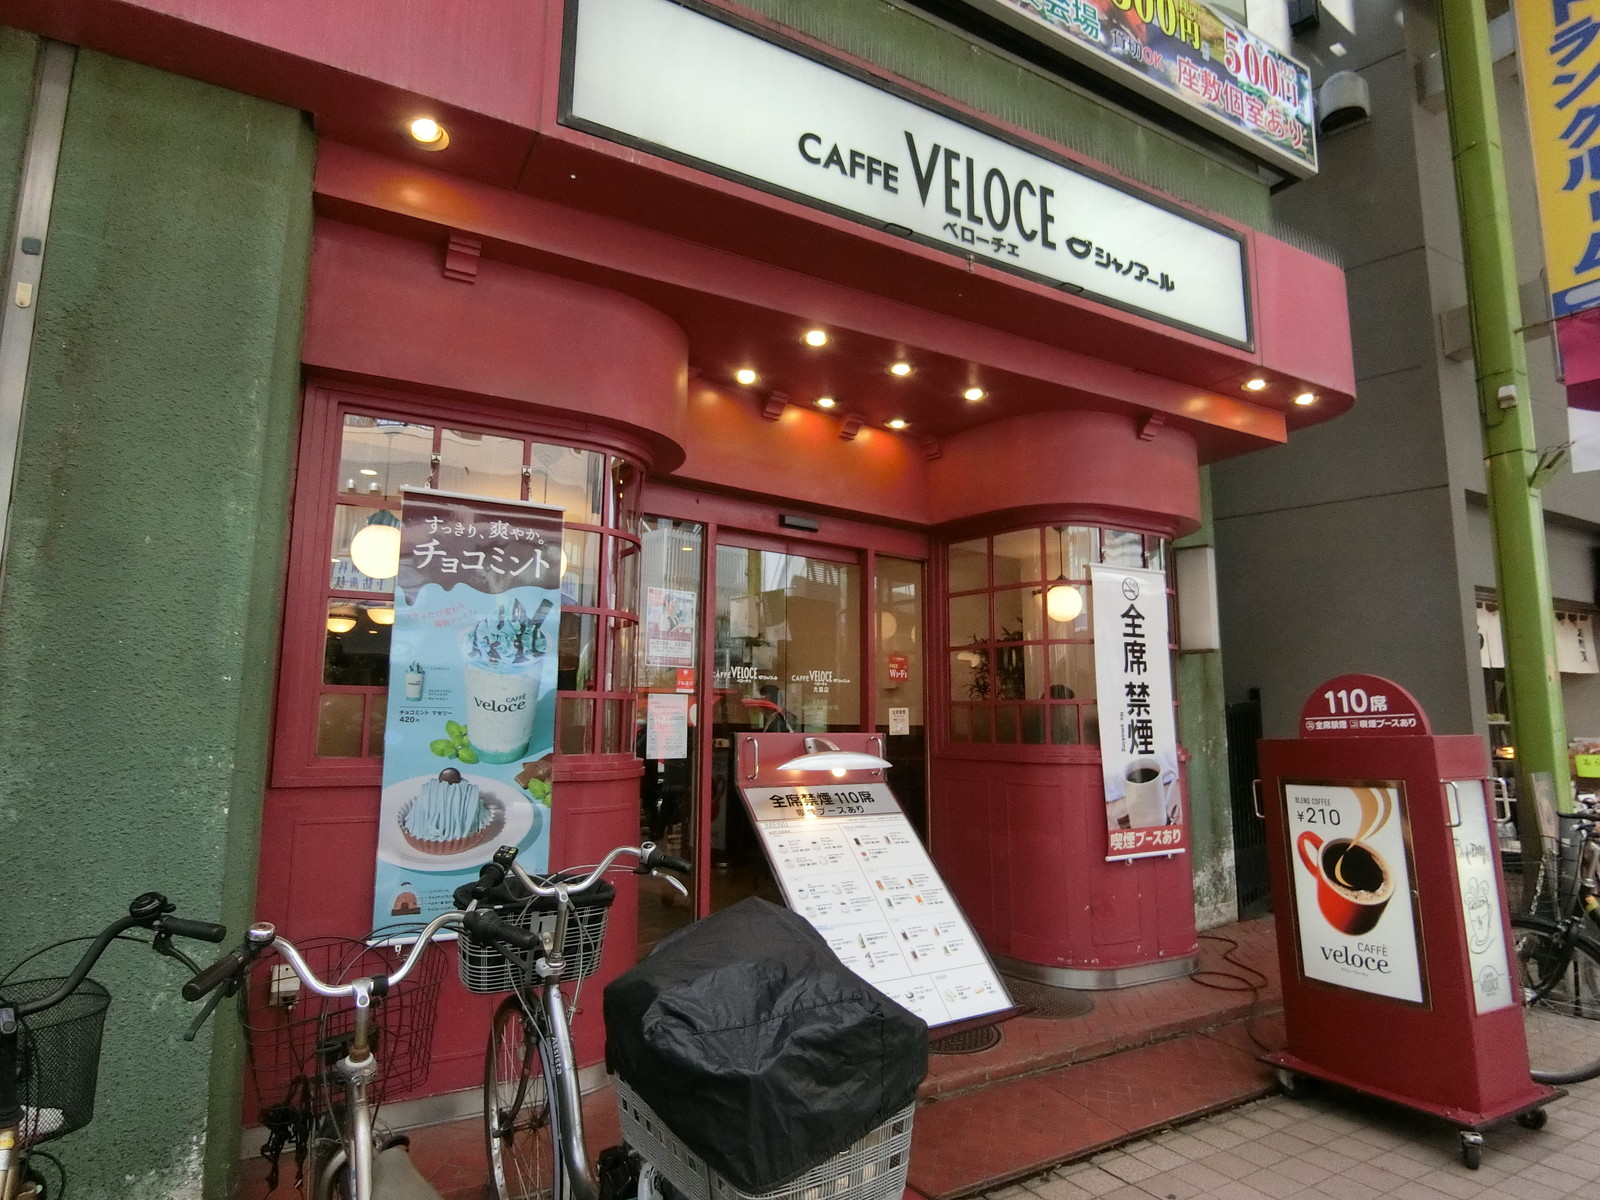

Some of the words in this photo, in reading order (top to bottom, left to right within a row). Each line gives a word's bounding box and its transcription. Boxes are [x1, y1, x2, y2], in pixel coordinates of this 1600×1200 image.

[1225, 31, 1298, 108] 500円
[1177, 57, 1303, 147] 座敷個室あり
[799, 132, 899, 195] CAFFE
[904, 131, 1057, 250] VELOCE
[943, 221, 1020, 258] ベローチェ
[1094, 247, 1176, 292] シャノアール
[425, 516, 545, 545] すっきり、爽やか。
[413, 539, 550, 578] チョコミント
[731, 666, 758, 680] VELOCE
[809, 670, 833, 682] VELOCE
[1120, 604, 1155, 755] 全席禁煙
[474, 697, 527, 713] veloce
[1324, 688, 1388, 714] 110席
[1297, 807, 1341, 826] ¥210
[1311, 798, 1332, 806] COFFEE
[1110, 829, 1182, 851] 喫煙ブースあり
[1320, 945, 1392, 974] veloce
[551, 1036, 562, 1075] Assista
